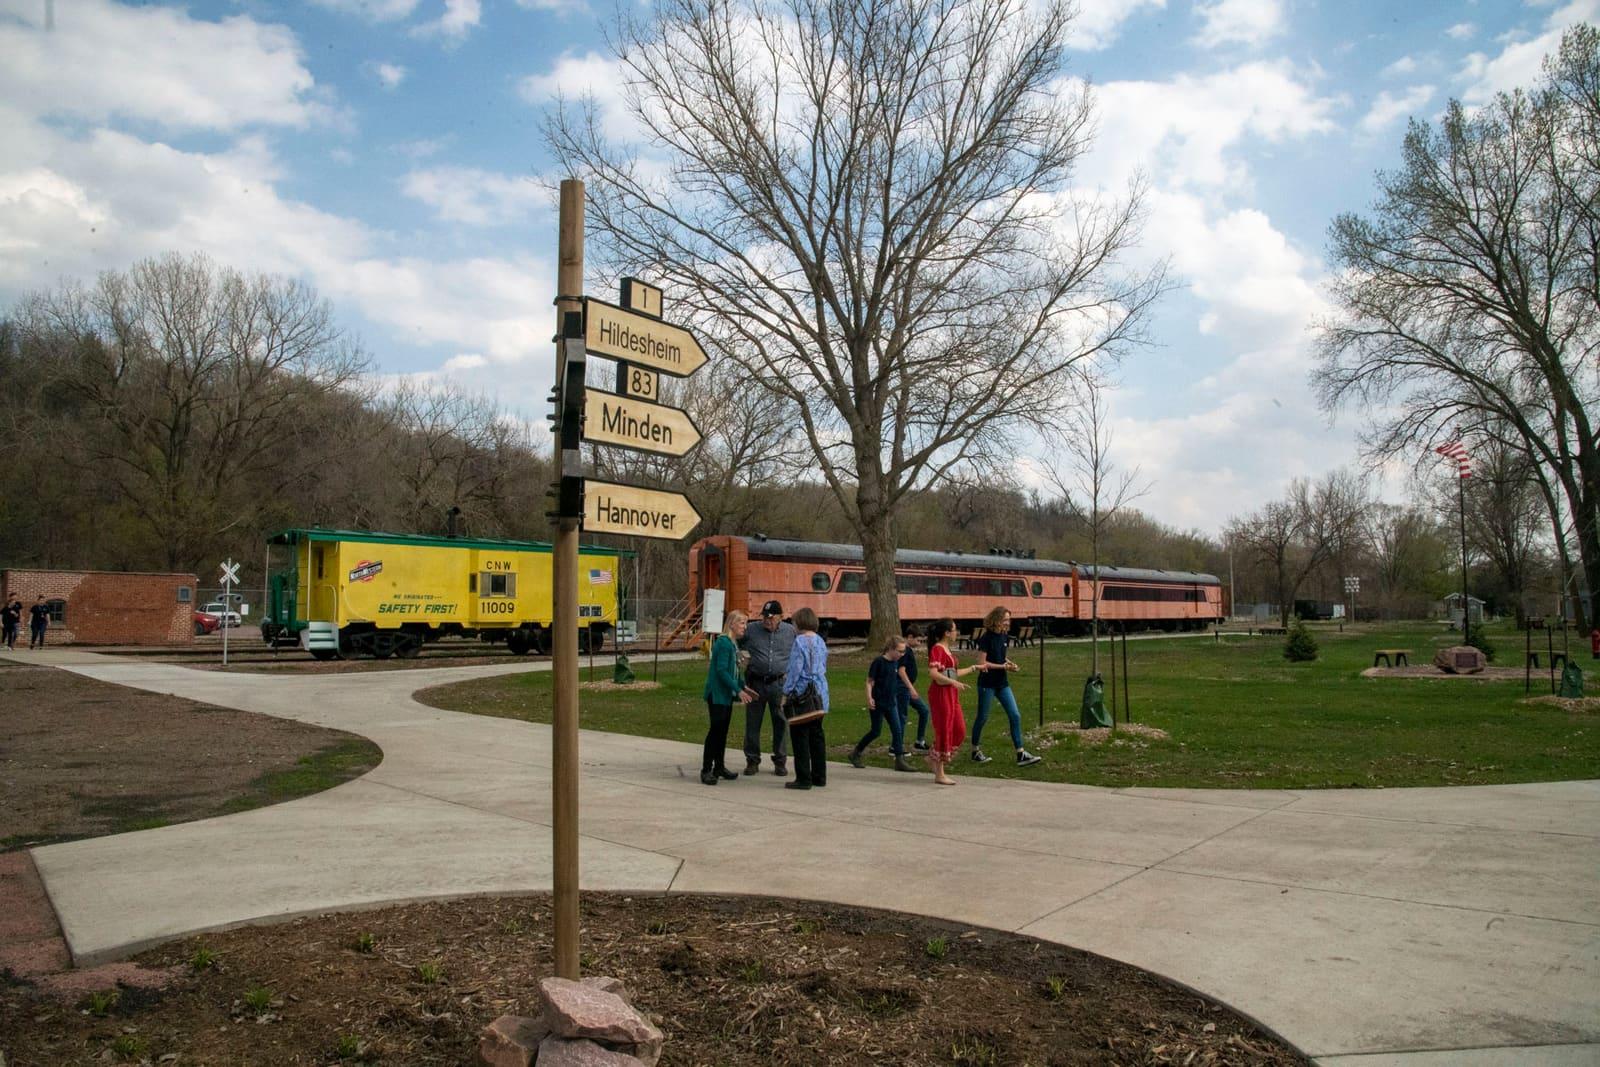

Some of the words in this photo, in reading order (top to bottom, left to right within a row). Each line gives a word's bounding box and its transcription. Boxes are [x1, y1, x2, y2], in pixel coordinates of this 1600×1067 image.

[642, 288, 648, 309] 1
[600, 318, 681, 364] Hildesheim
[631, 370, 652, 396] 83
[602, 402, 672, 445] Minden
[597, 495, 676, 530] Hannover
[486, 561, 512, 570] CNW
[378, 603, 421, 614] SAFETY
[424, 603, 458, 615] FIRST!
[481, 601, 515, 614] 11009
